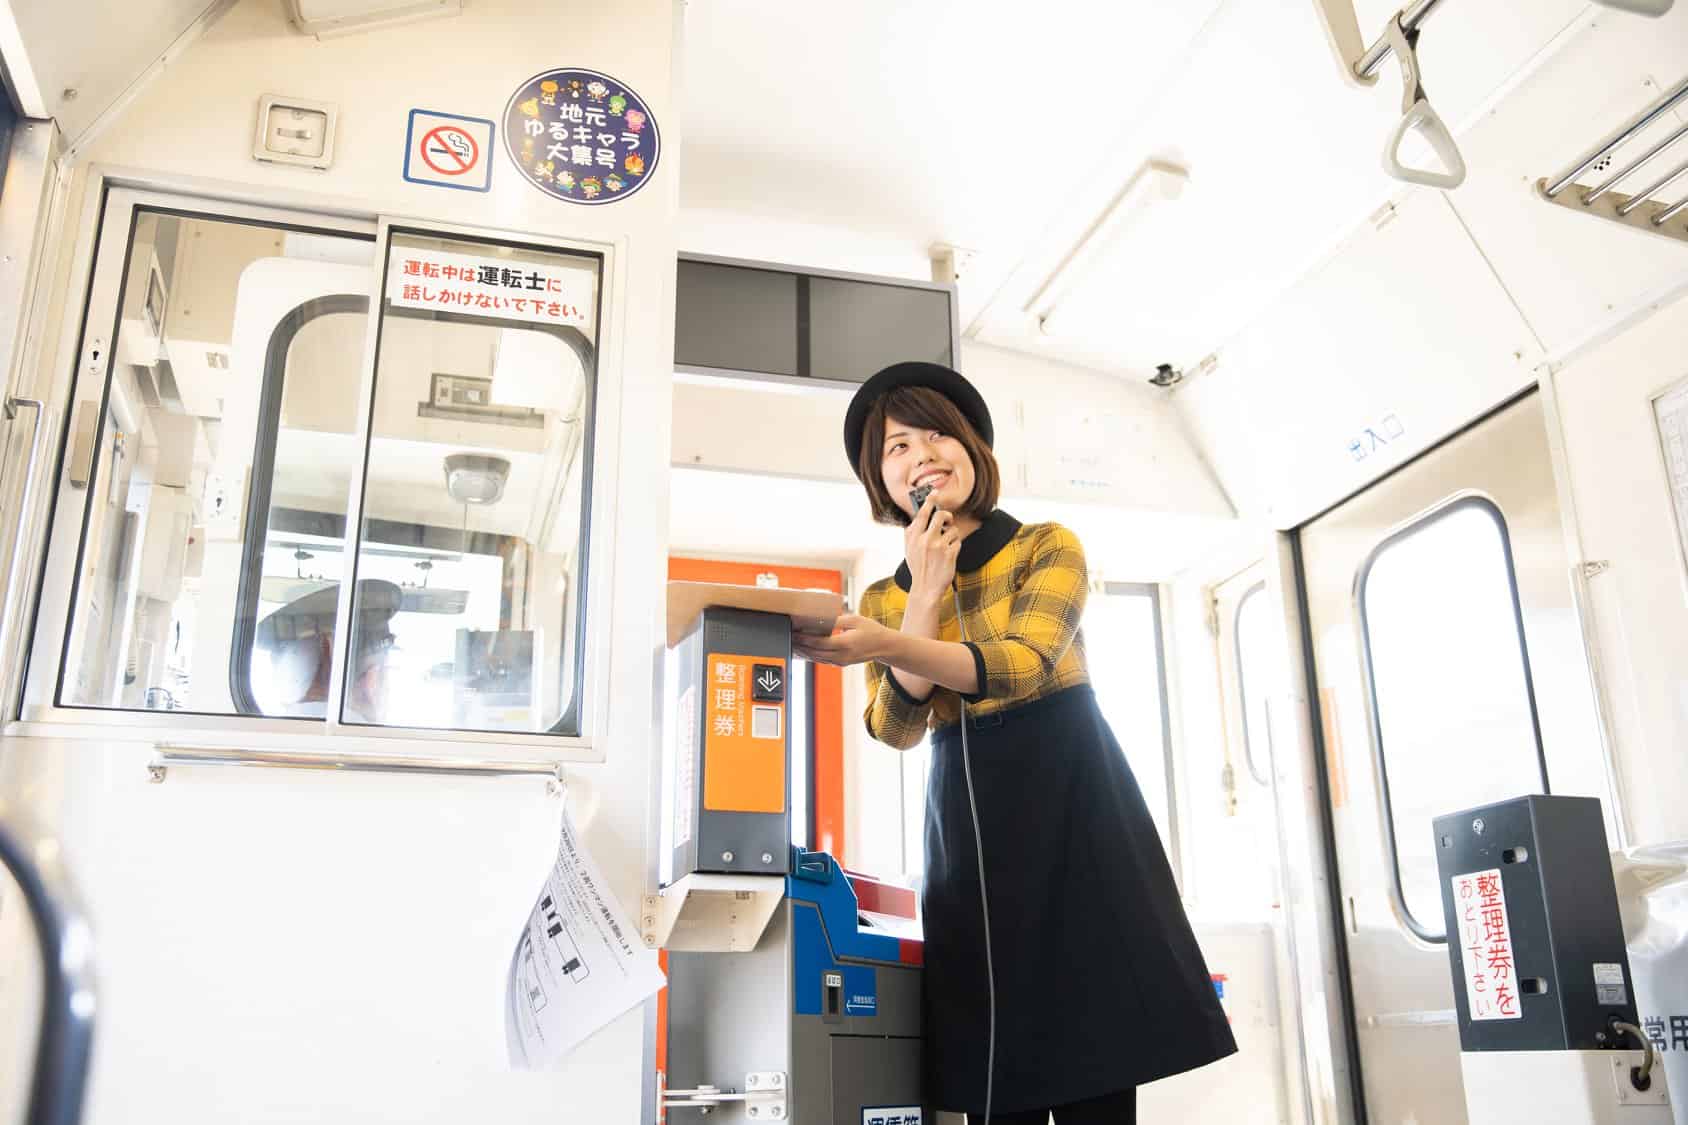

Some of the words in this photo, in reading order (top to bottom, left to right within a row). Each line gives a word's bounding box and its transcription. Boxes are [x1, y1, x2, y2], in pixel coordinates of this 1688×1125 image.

[560, 103, 607, 127] 地元
[524, 119, 641, 150] ゆるキャラ
[547, 143, 617, 169] 大集号
[403, 259, 563, 293] 運転中は運転士に
[402, 285, 585, 320] 話しかけないで下さい。
[1347, 412, 1405, 462] 出入口
[713, 661, 736, 737] 整理券
[1459, 879, 1490, 1016] おとり下さい
[1476, 871, 1515, 1015] 整理券を
